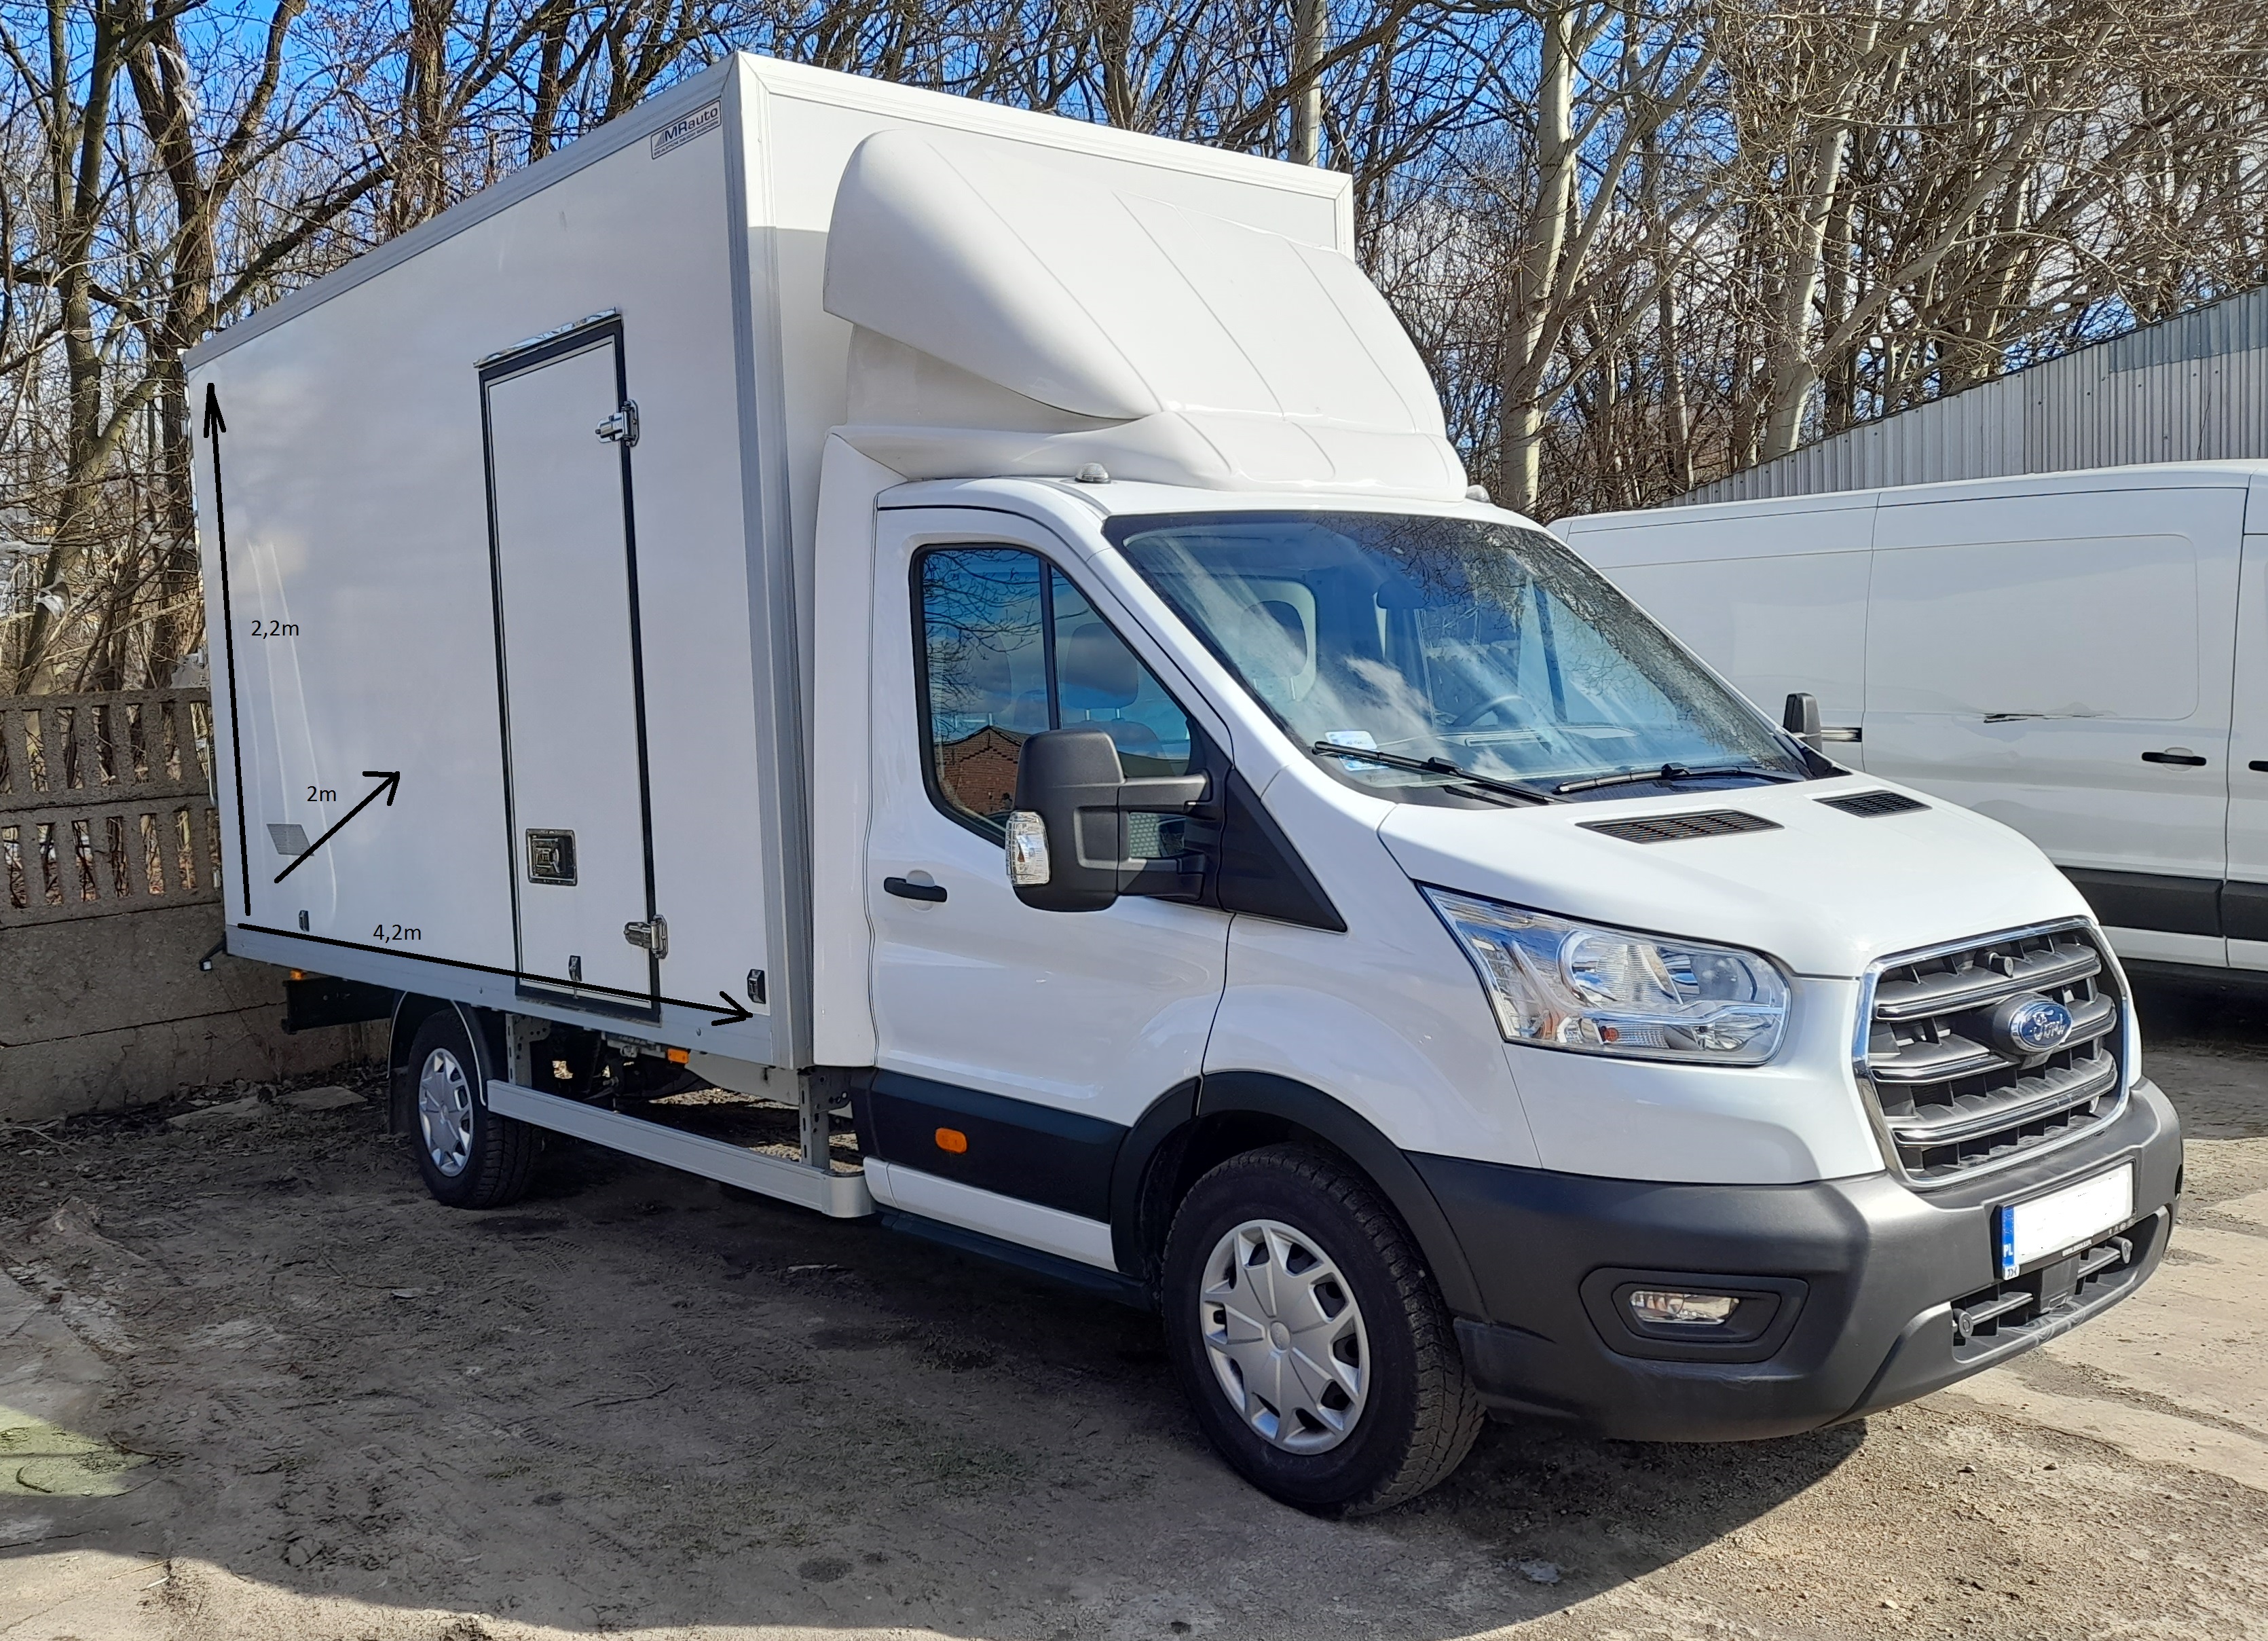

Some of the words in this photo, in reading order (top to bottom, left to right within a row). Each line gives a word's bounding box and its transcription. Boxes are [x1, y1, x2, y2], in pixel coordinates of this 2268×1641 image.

[665, 107, 718, 143] MRauto
[2027, 1009, 2065, 1041] Ford
[2003, 1243, 2013, 1258] PL
